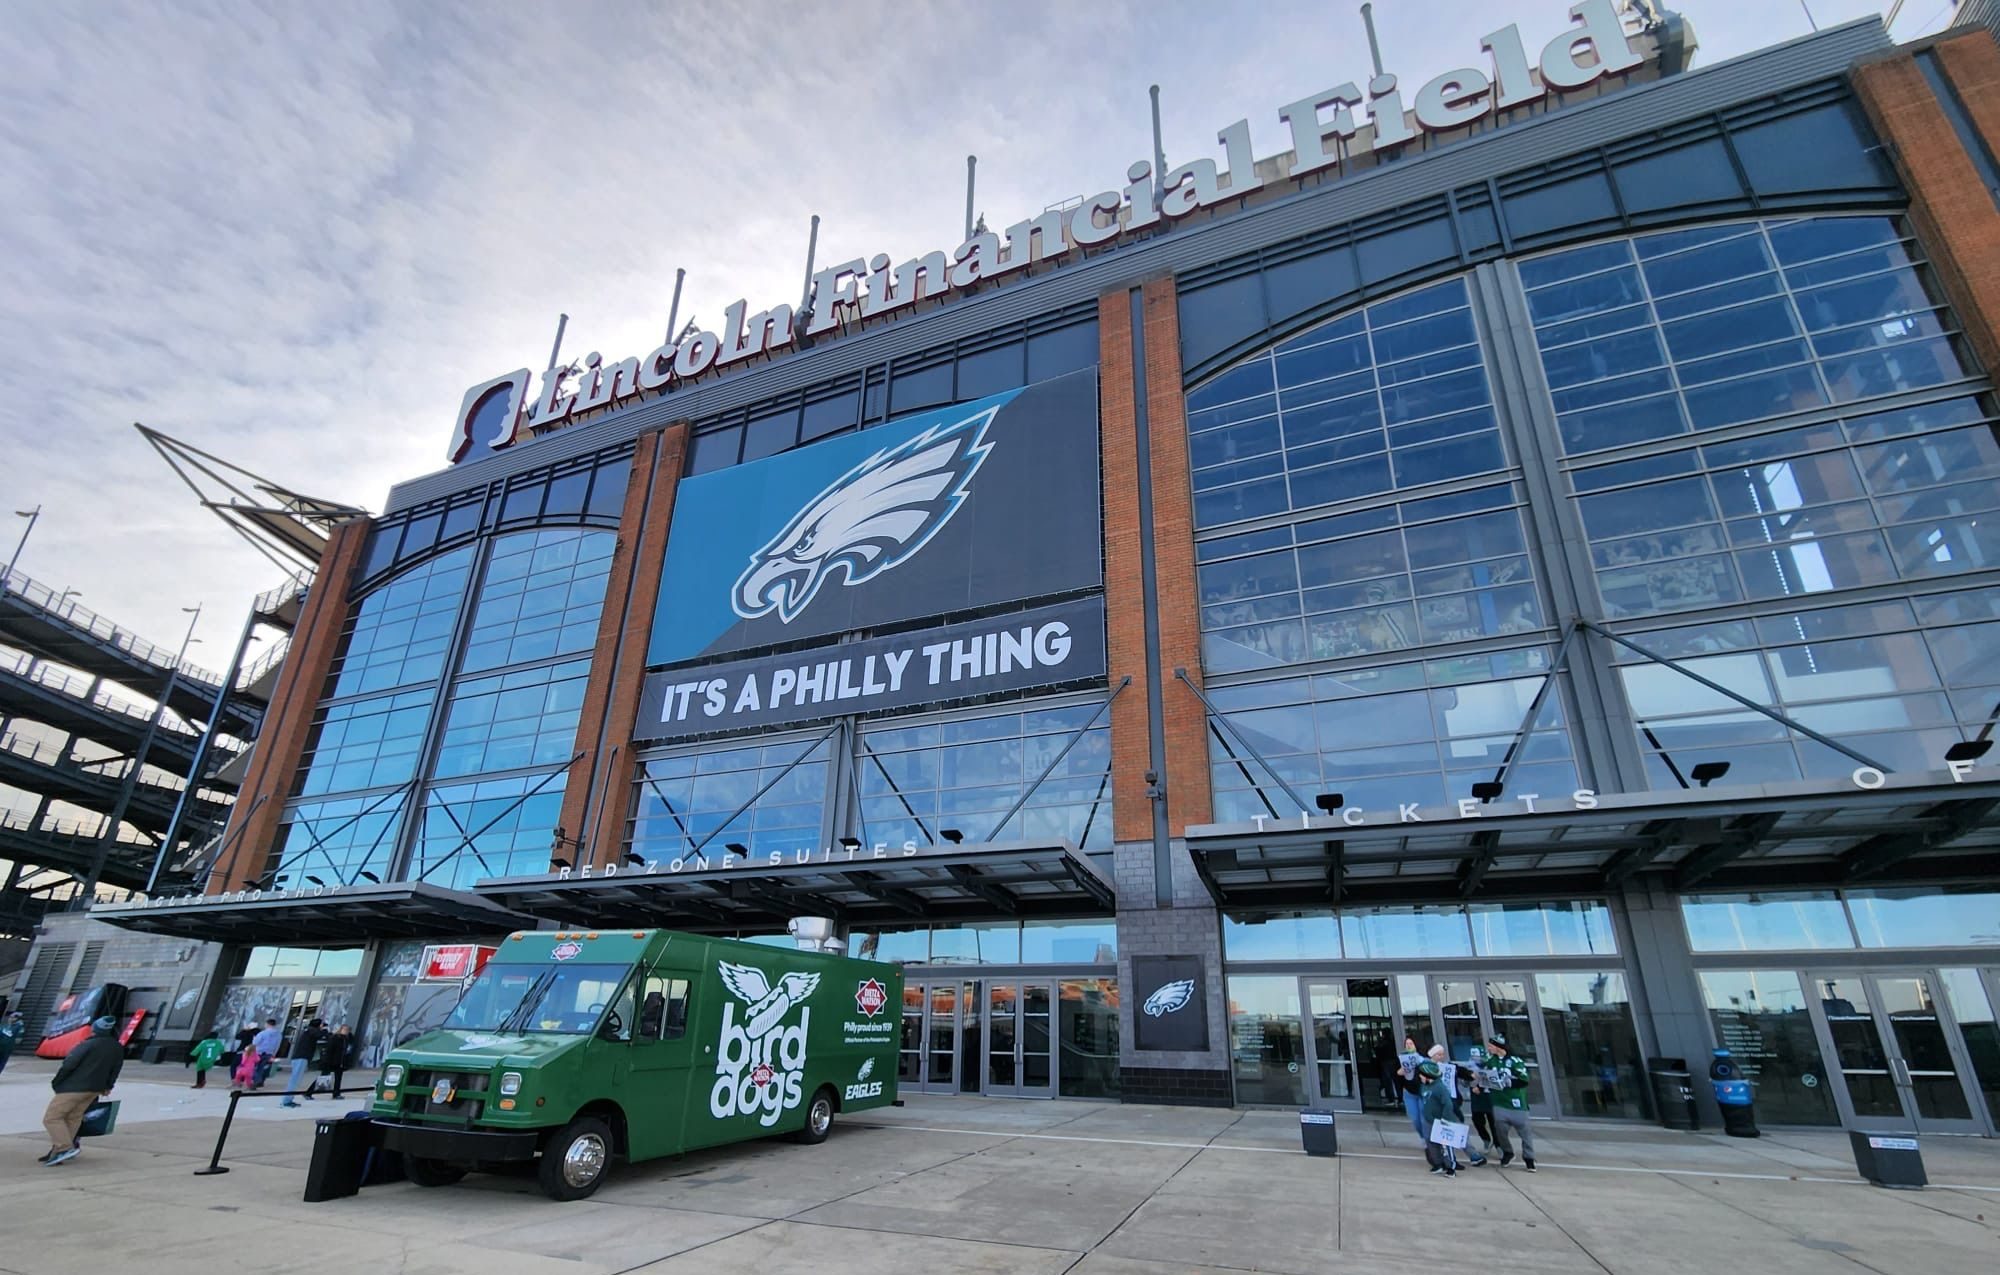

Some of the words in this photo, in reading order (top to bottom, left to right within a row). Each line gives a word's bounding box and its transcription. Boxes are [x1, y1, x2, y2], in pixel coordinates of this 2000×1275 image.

[529, 298, 794, 429] Lincoln
[807, 118, 1264, 337] Financial
[1279, 0, 1643, 183] Field
[661, 678, 728, 723] IT'S
[733, 674, 760, 714] A
[769, 649, 913, 709] PHILLY
[922, 621, 1072, 685] THING
[1251, 789, 1600, 834] TICKETS
[559, 863, 617, 881] RED
[647, 854, 736, 876] ZONE
[768, 841, 918, 866] SUITES
[127, 894, 206, 909] EAGLES
[220, 889, 263, 904] PRO
[279, 884, 342, 899] SHOP
[716, 1002, 811, 1075] bird
[857, 1022, 872, 1035] proud
[871, 1022, 882, 1033] since
[710, 1066, 804, 1128] dogs
[844, 1081, 883, 1101] EAGLES
